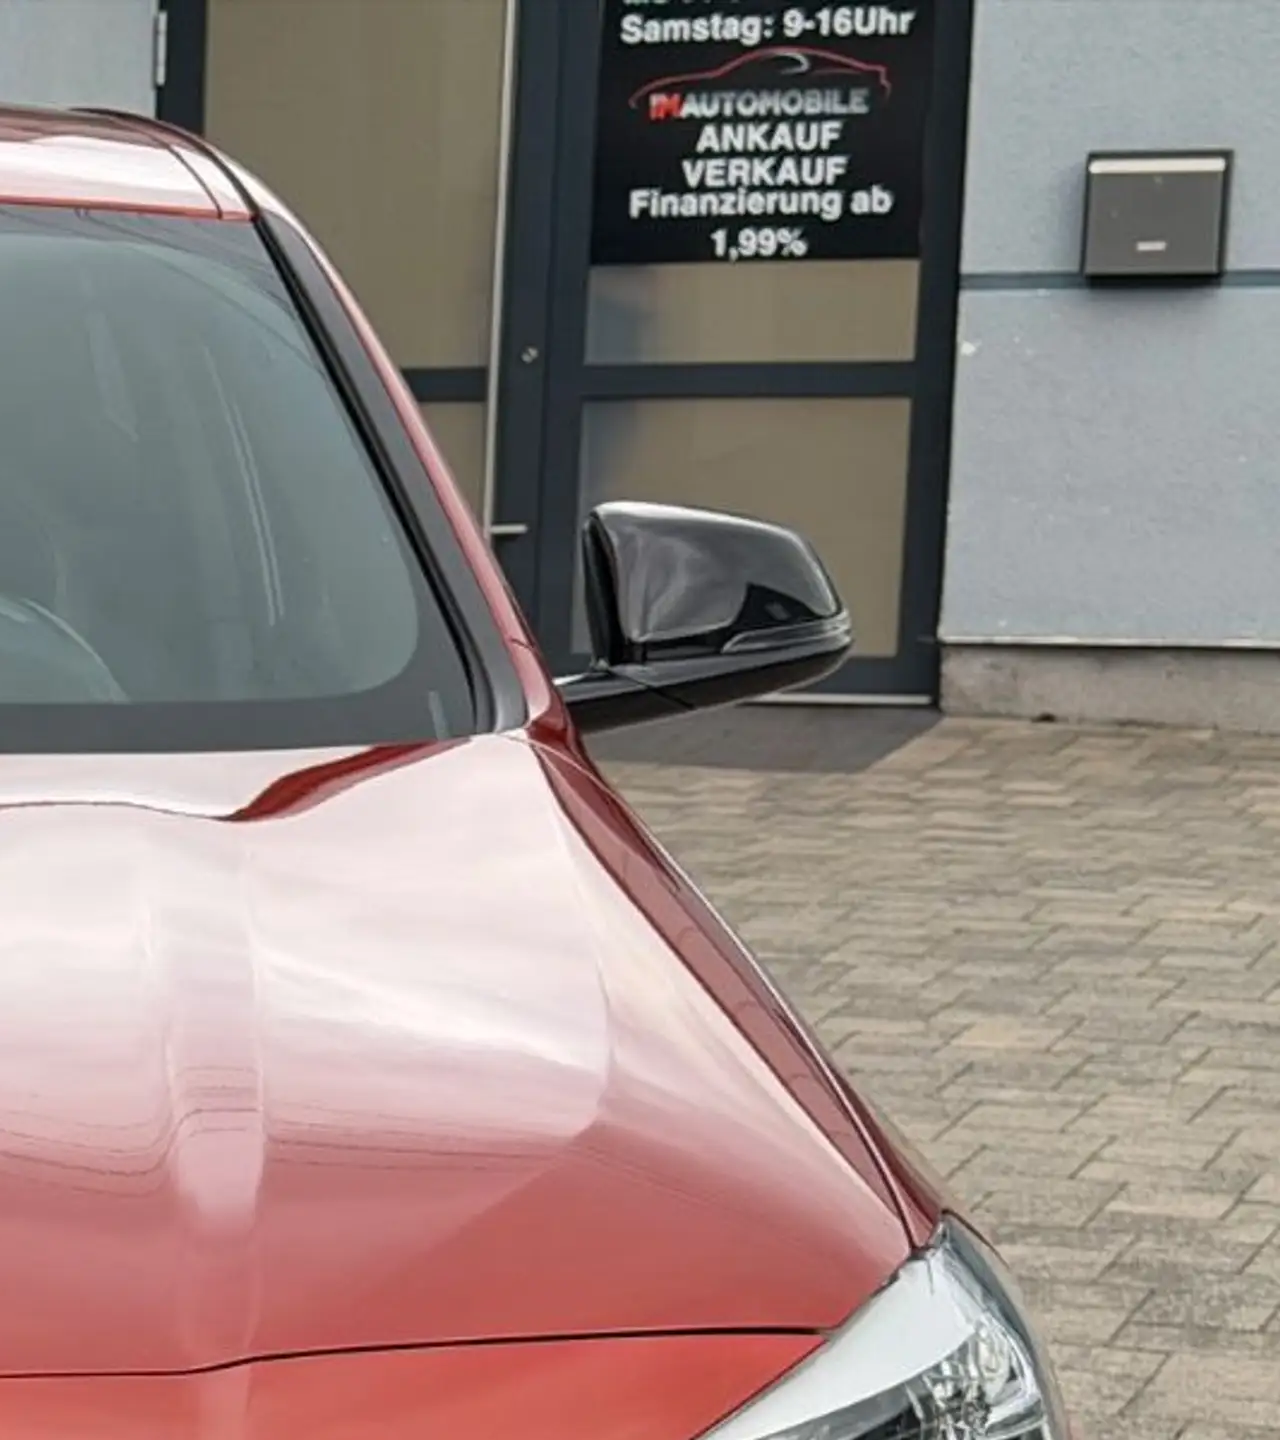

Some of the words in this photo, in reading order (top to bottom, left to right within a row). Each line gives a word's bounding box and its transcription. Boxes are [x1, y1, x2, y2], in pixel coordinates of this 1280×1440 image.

[619, 13, 775, 46] Samstag:
[781, 7, 916, 38] 9-16Uhr
[696, 121, 844, 153] ANKAUF
[681, 155, 848, 188] VERKAUF
[628, 187, 843, 221] Finanzierung
[849, 184, 894, 214] ab
[709, 227, 809, 262] 1,99%
